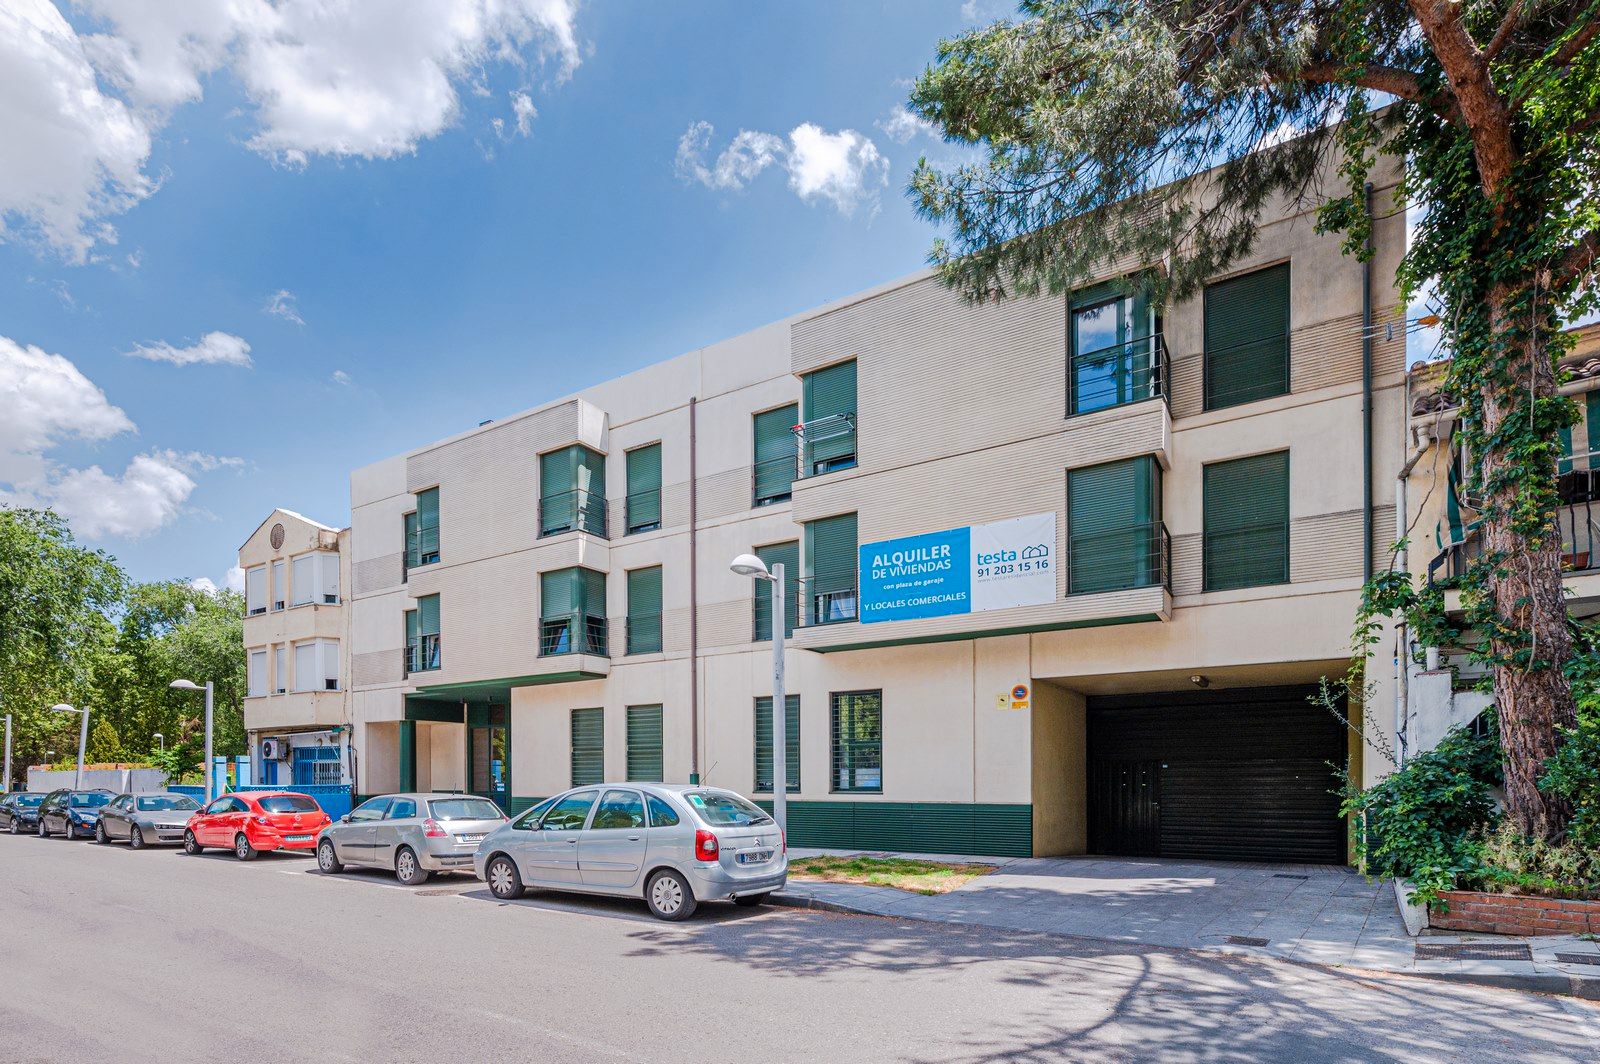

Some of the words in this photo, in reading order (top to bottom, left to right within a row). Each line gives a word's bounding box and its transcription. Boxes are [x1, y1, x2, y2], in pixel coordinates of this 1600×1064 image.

[872, 544, 951, 567] ALQUILER
[977, 549, 1017, 566] testa
[872, 568, 887, 580] DE
[889, 559, 952, 577] VIVIENDAS
[977, 567, 990, 578] 91
[994, 564, 1014, 575] 203
[1017, 562, 1031, 572] 15
[1035, 559, 1049, 570] 16
[896, 581, 912, 589] plaza
[923, 577, 944, 586] garaje
[864, 603, 870, 611] Y
[871, 599, 906, 610] LOCALES
[907, 592, 966, 606] COMERCIALES
